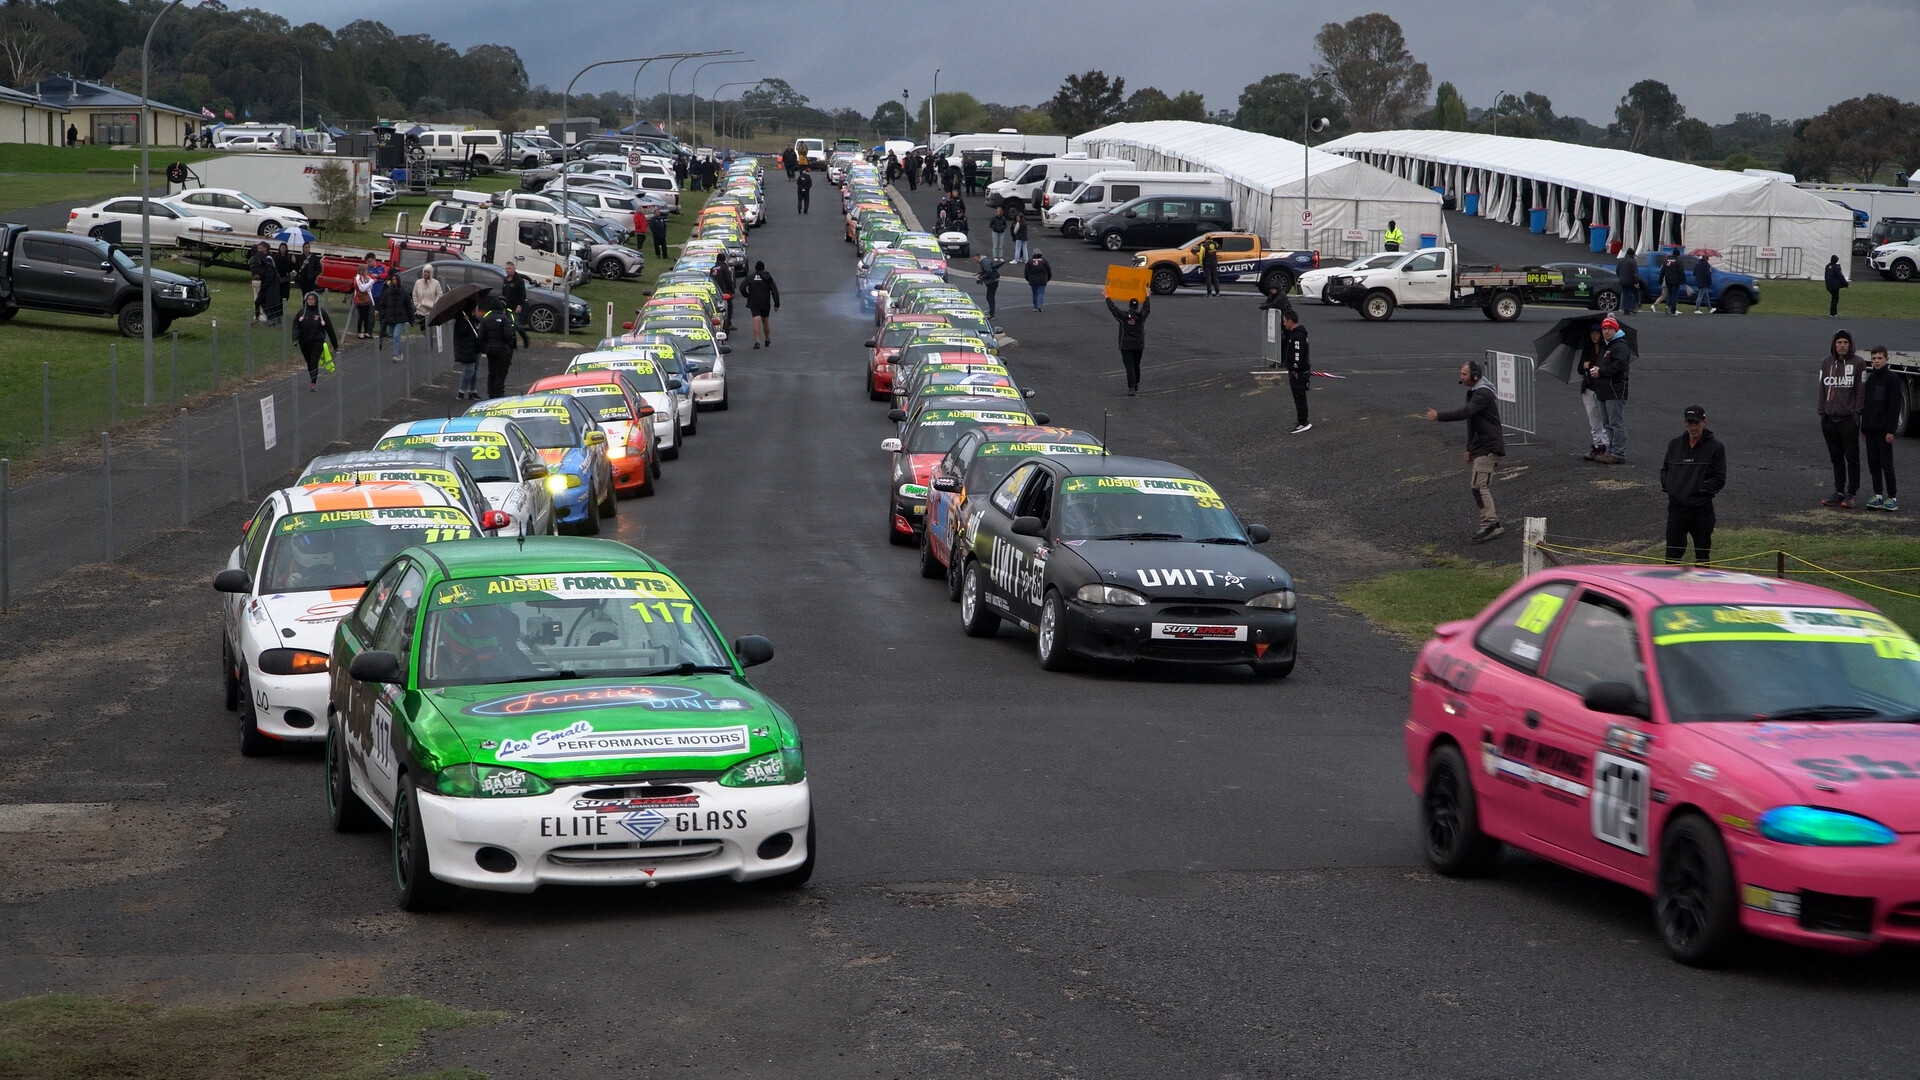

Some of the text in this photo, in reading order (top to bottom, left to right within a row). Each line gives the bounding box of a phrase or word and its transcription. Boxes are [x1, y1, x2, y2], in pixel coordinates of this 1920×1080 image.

[1540, 274, 1548, 282] 02
[577, 386, 616, 394] FORKLIFTS
[404, 436, 440, 445] AUSSIE
[471, 446, 500, 460] 26
[333, 472, 446, 482] AUSSIE FORKLIFTS
[1098, 478, 1206, 493] AUSSIE FORKLIFTS
[1194, 496, 1225, 510] 35
[320, 508, 458, 522] AUSSIE FORKLIFTS
[424, 528, 471, 544] 111
[487, 577, 558, 594] AUSSIE
[563, 576, 666, 592] FORKLIFTS
[630, 602, 694, 624] 117
[1163, 625, 1238, 635] SUPASHOCK
[650, 698, 741, 710] DINER
[376, 712, 390, 768] 117
[500, 722, 590, 758] Les Small
[558, 732, 740, 750] PERFORMANCE MOTORS
[540, 809, 748, 838] ELITE GLASS
